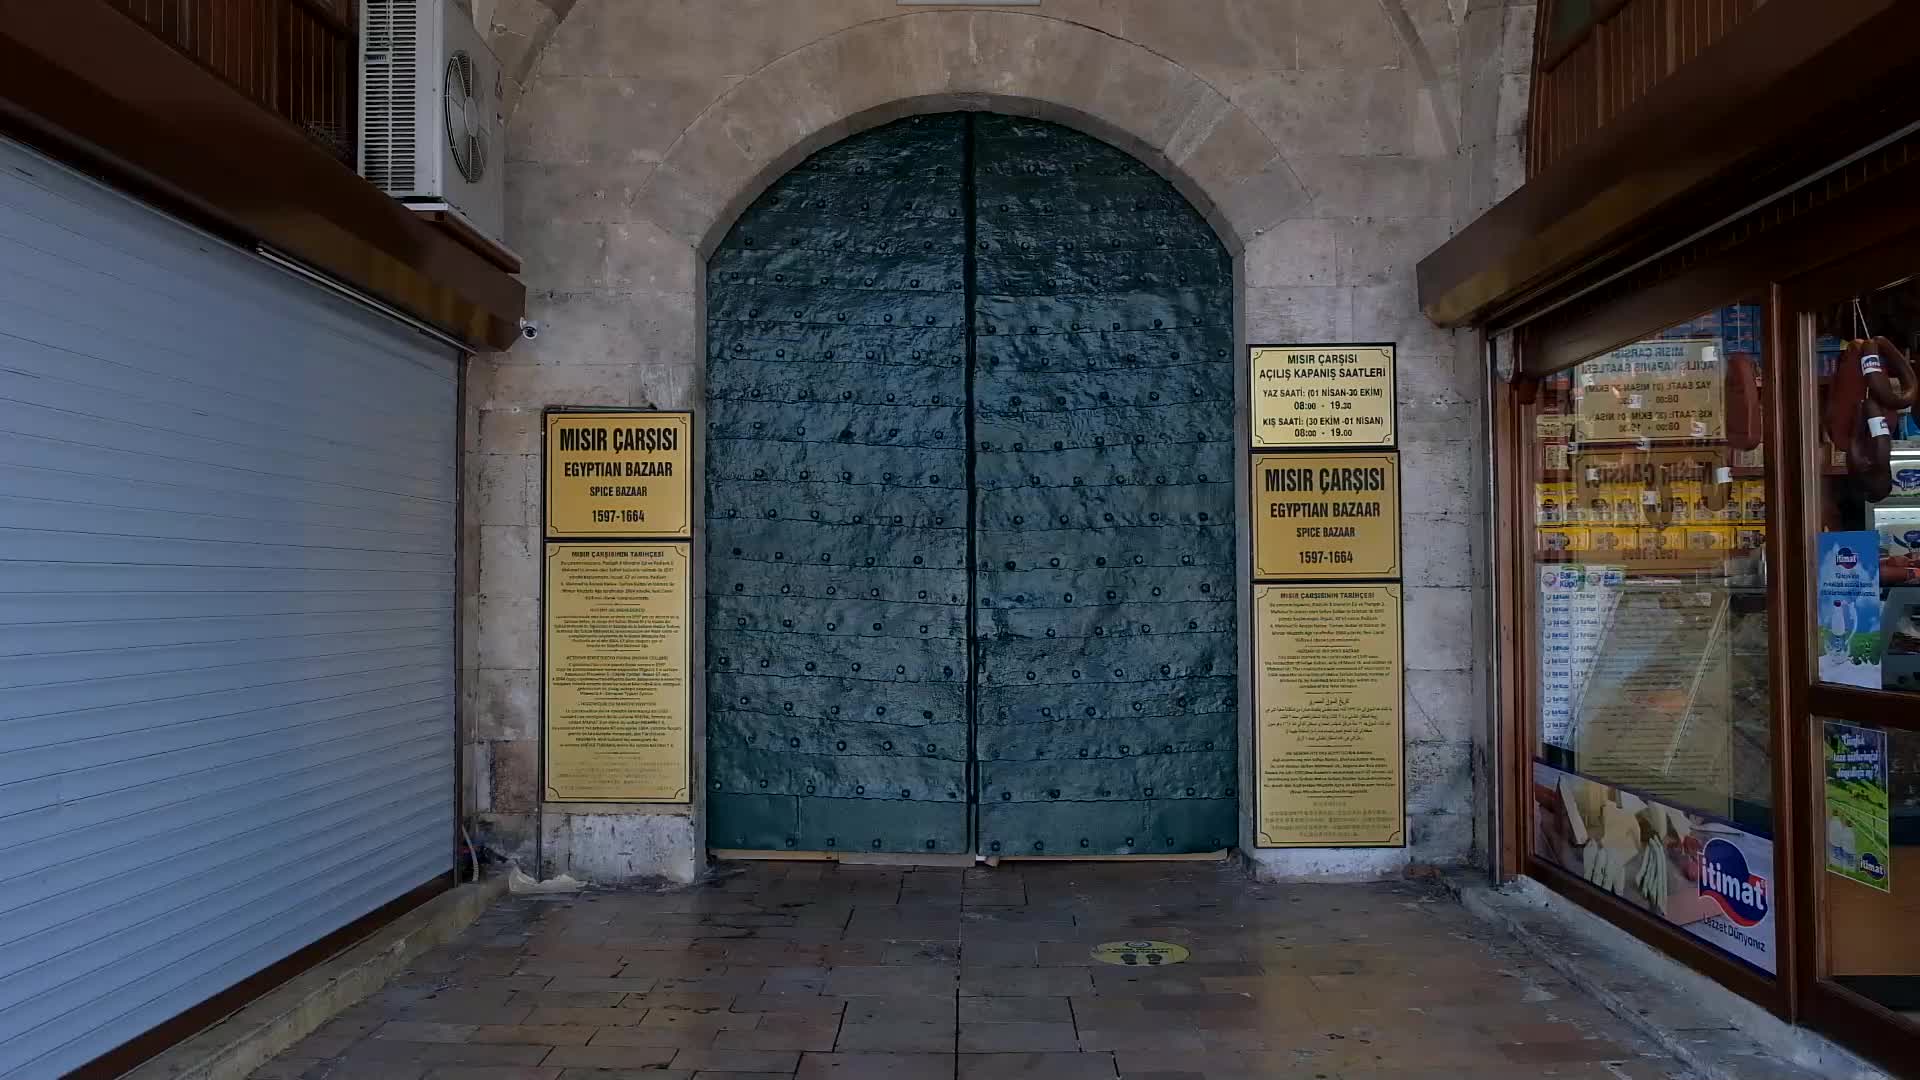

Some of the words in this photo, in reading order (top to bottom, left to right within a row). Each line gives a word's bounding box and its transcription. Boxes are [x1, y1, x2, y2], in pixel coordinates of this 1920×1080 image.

[1288, 354, 1315, 364] MISIR
[1318, 354, 1358, 366] ÇARŞISI
[1260, 369, 1291, 381] AÇILIŞ
[1294, 368, 1336, 380] KAPANIŞ
[1340, 367, 1386, 378] SAATLERİ
[1263, 390, 1278, 398] YAZ
[1280, 386, 1305, 397] SAATİ:
[1308, 389, 1319, 399] (01
[1360, 386, 1383, 398] EKİM)
[1294, 402, 1316, 410] 08:00
[1263, 418, 1276, 428] KIŞ
[1278, 415, 1304, 426] SAATİ:
[1306, 418, 1318, 428] (30
[1320, 415, 1340, 426] EKİM
[1294, 429, 1316, 437] 08:00
[1330, 428, 1352, 437] 19.00
[560, 428, 607, 451] MISIR
[613, 428, 677, 454] ÇARŞISI
[564, 462, 621, 477] EGYPTIAN
[626, 462, 672, 477] BAZAAR
[1265, 468, 1313, 492] MISIR
[1319, 468, 1384, 494] ÇARŞISI
[590, 486, 613, 497] SPICE
[616, 486, 647, 496] BAZAAR
[592, 510, 645, 522] 1597-1664
[1270, 503, 1328, 518] EGYPTIAN
[1332, 502, 1380, 517] BAZAAR
[1296, 527, 1320, 538] SPICE
[1323, 527, 1354, 537] BAZAAR
[1300, 551, 1353, 564] 1597-1664
[1860, 856, 1884, 875] itimat
[1702, 856, 1764, 911] itimat
[1704, 912, 1727, 935] Lezzet
